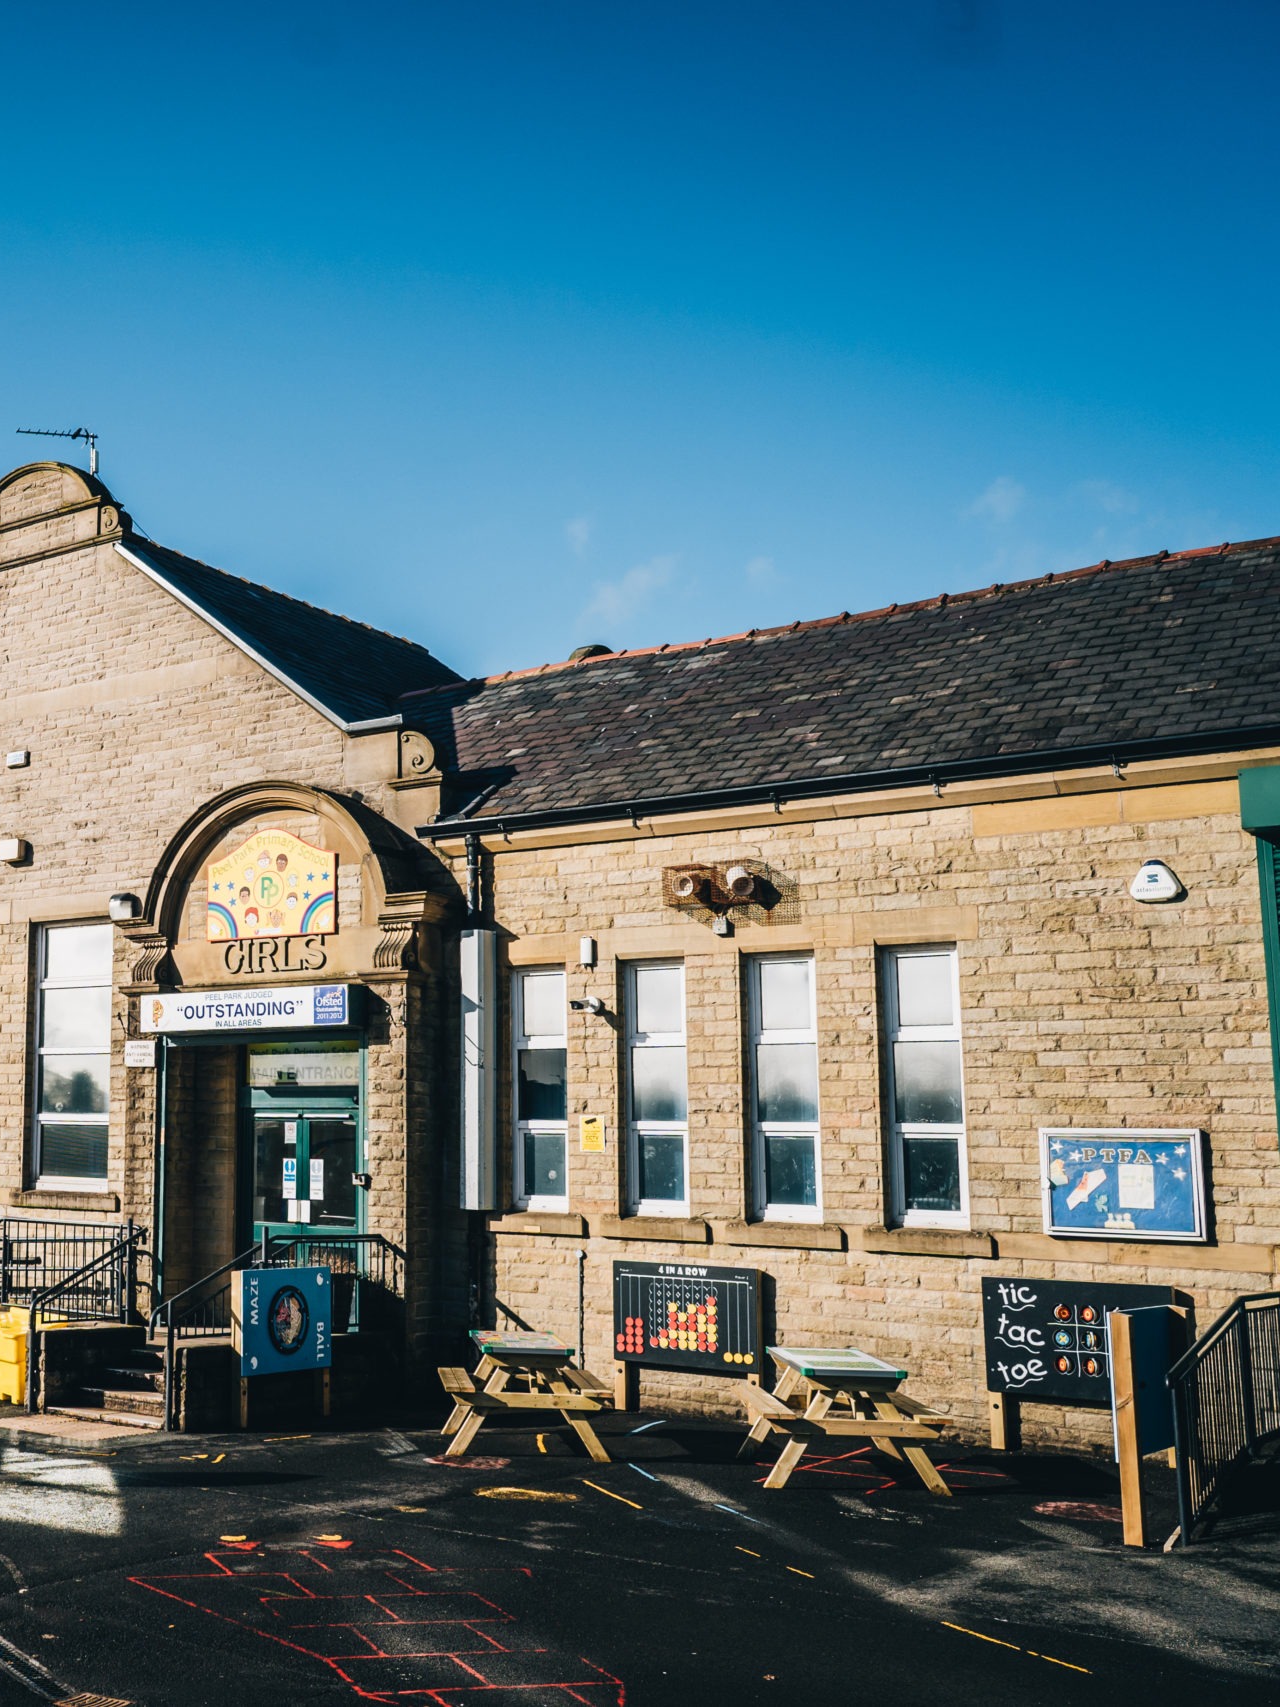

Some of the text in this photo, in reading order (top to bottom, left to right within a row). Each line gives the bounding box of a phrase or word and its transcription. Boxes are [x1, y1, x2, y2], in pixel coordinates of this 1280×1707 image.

[212, 834, 330, 877] Peel Park Primary School
[224, 936, 328, 975] GIRLS
[205, 990, 273, 1001] PEEL PARK JUDGED
[315, 996, 343, 1007] Ofsted
[215, 1020, 223, 1028] IN
[237, 1018, 263, 1027] AREAS
[286, 1066, 360, 1080] ENTRANCE
[1081, 1147, 1153, 1164] PTFA
[658, 1265, 708, 1277] 4 IN A ROW
[250, 1276, 259, 1326] MAZE
[997, 1283, 1038, 1305] tic
[997, 1313, 1046, 1346] tac
[316, 1321, 325, 1362] BALL
[997, 1358, 1048, 1383] toe
